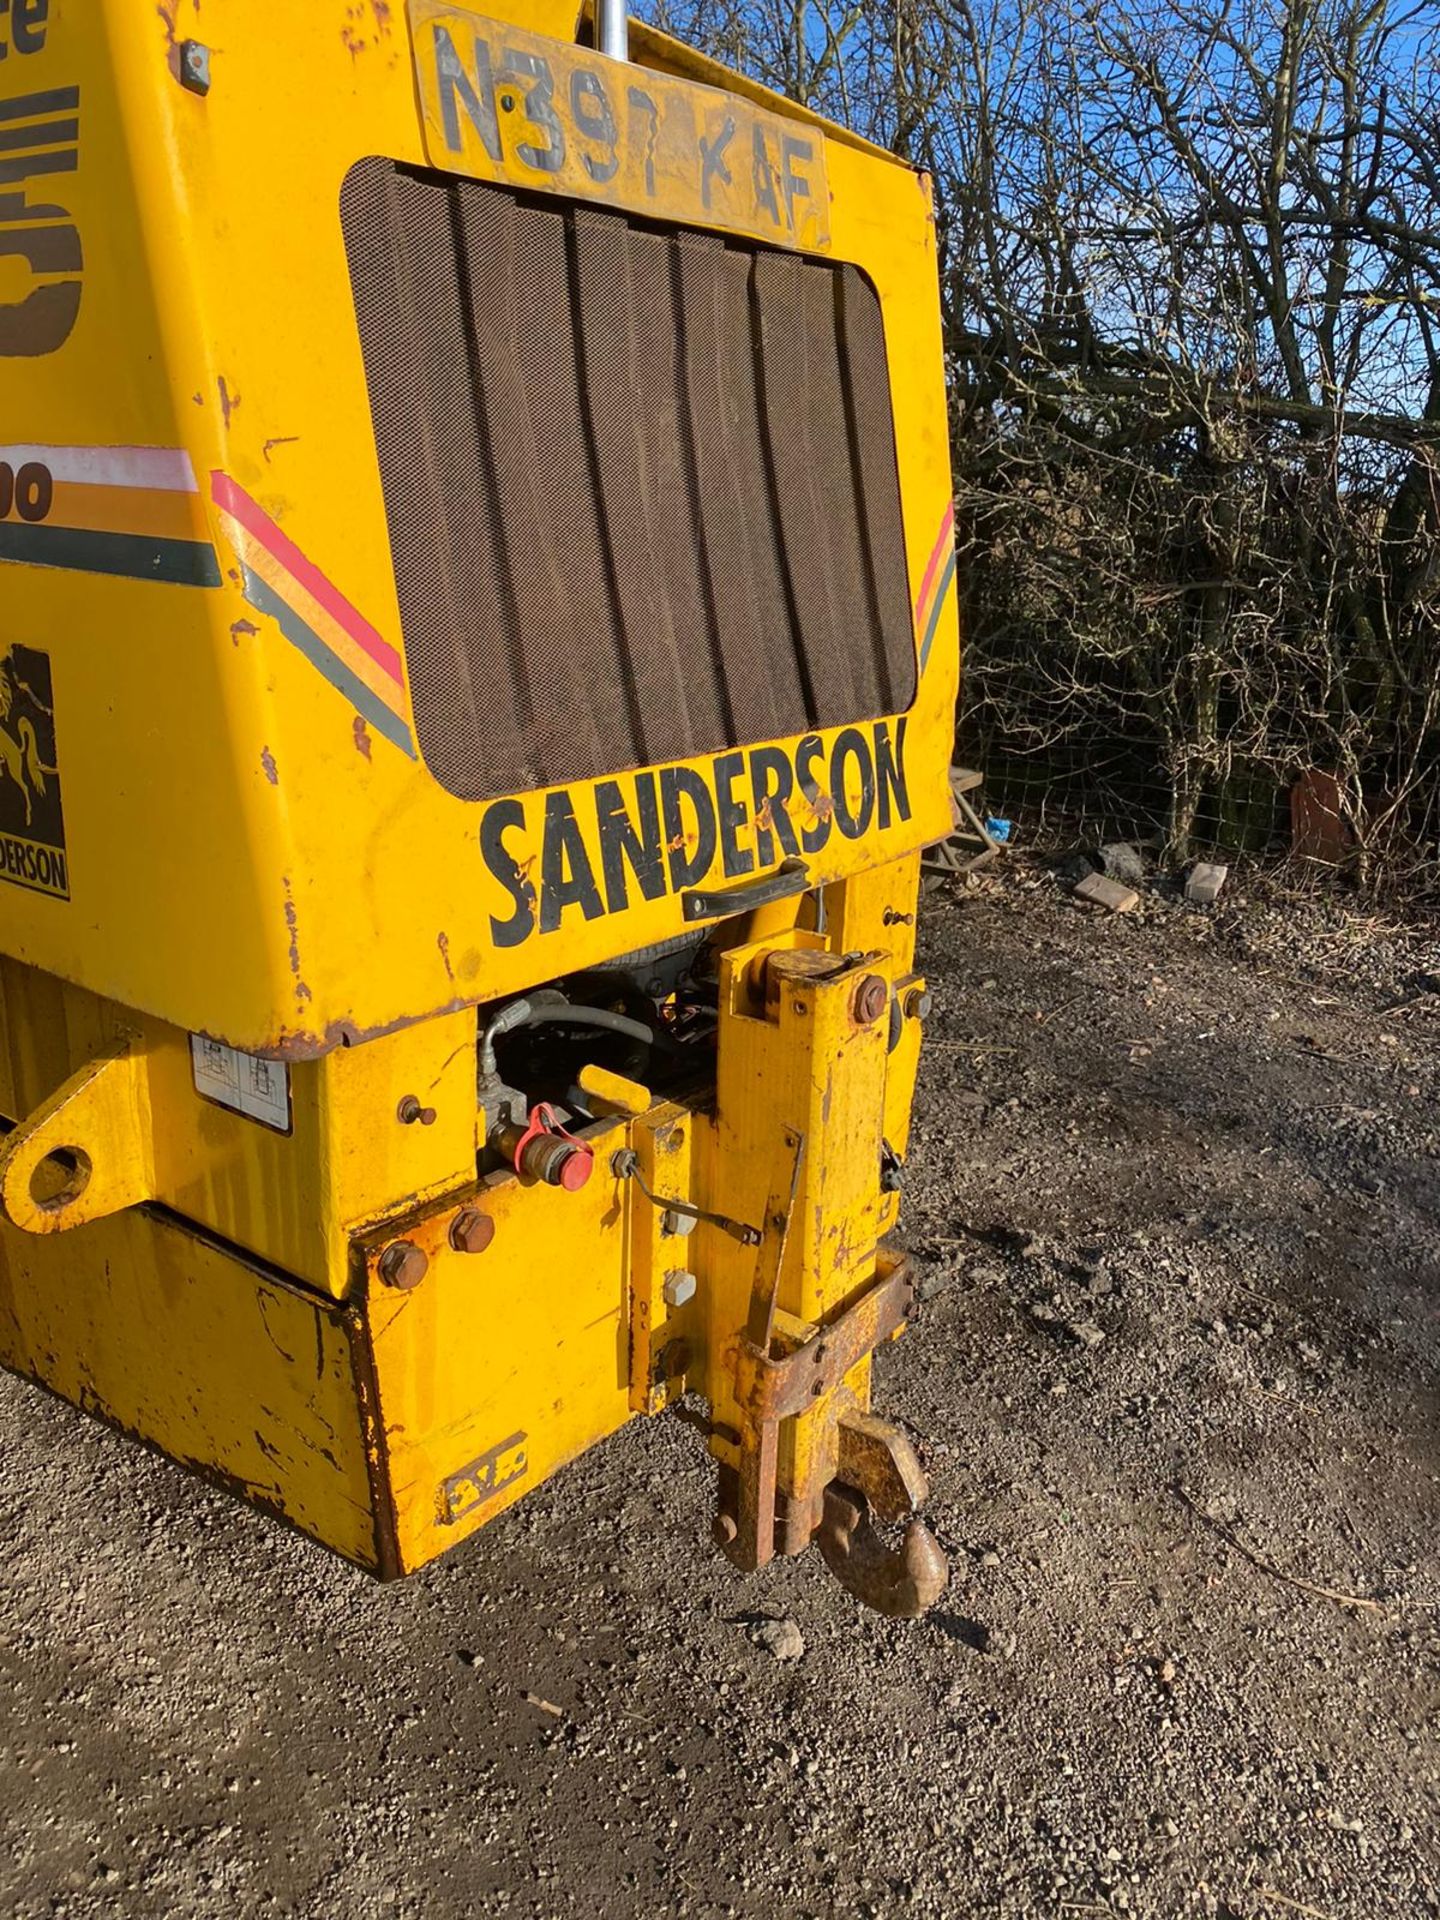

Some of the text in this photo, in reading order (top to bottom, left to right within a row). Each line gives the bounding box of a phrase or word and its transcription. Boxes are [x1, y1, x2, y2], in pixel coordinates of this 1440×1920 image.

[433, 25, 813, 231] N397 KAF
[479, 716, 912, 949] SANDERSON
